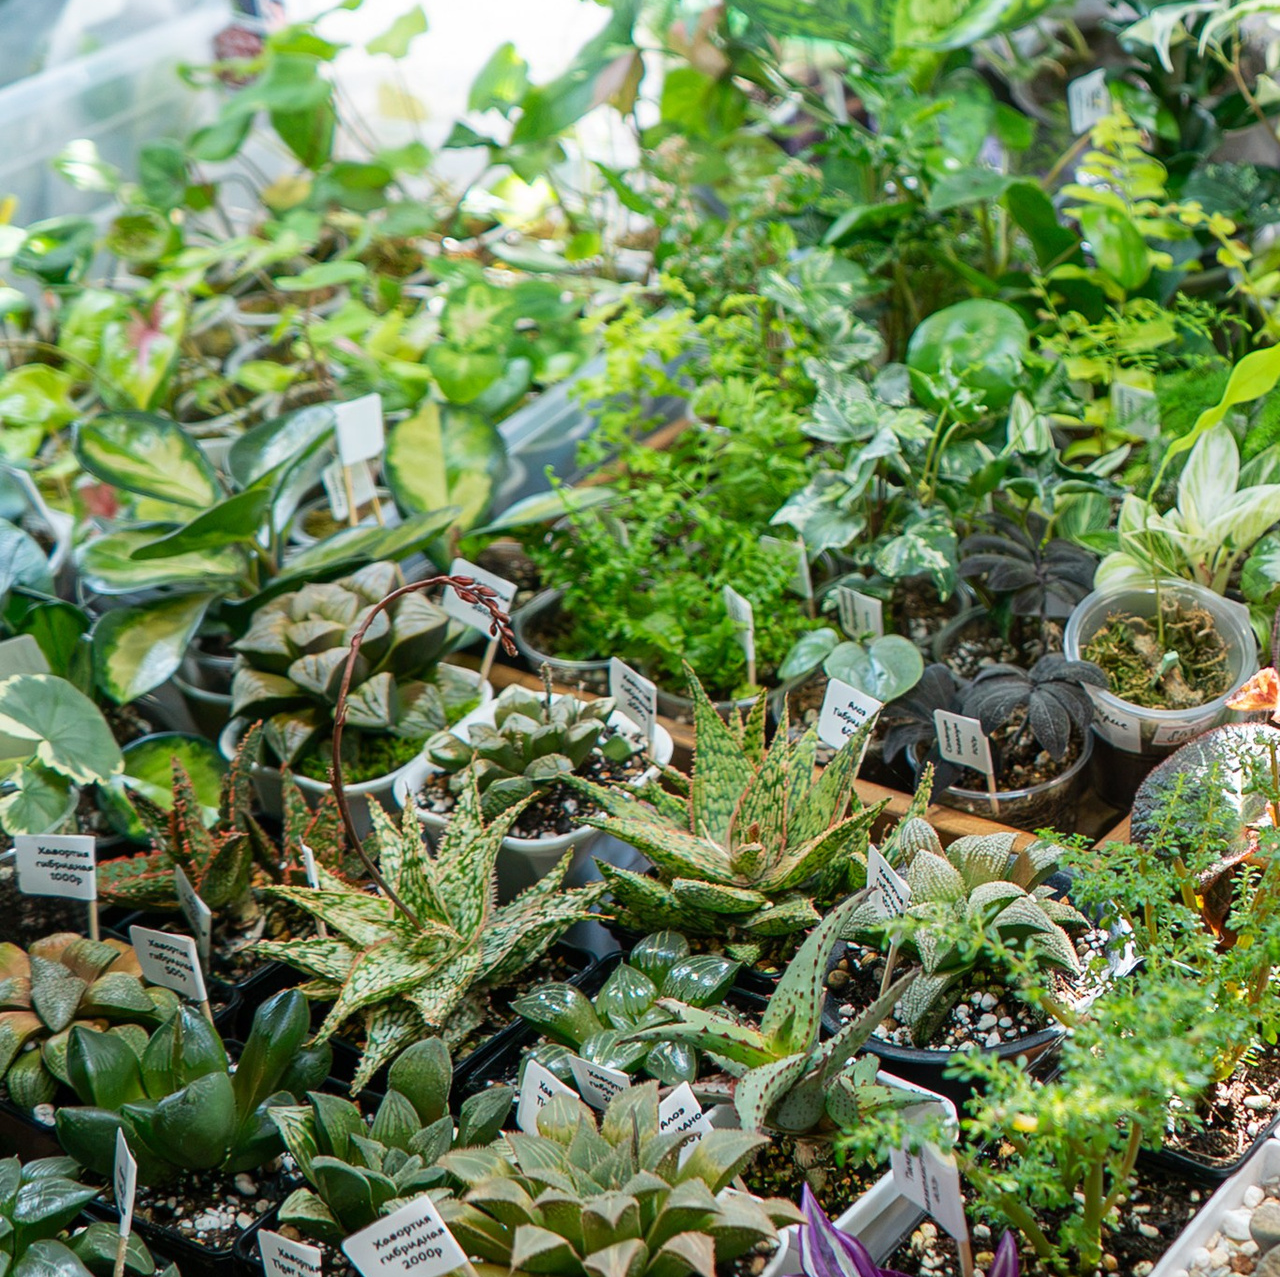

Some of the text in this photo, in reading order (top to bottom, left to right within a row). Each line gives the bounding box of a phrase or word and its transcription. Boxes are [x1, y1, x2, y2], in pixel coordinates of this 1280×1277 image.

[37, 846, 90, 859] Хавортия
[35, 859, 94, 873] гибридная
[49, 872, 83, 885] 1000р
[148, 938, 189, 959] Хавортия
[660, 1107, 685, 1131] Алоэ
[373, 1215, 432, 1250] Хавортия
[380, 1227, 446, 1265] гибридная
[277, 1247, 322, 1273] Хавортия
[402, 1247, 443, 1270] 2000р
